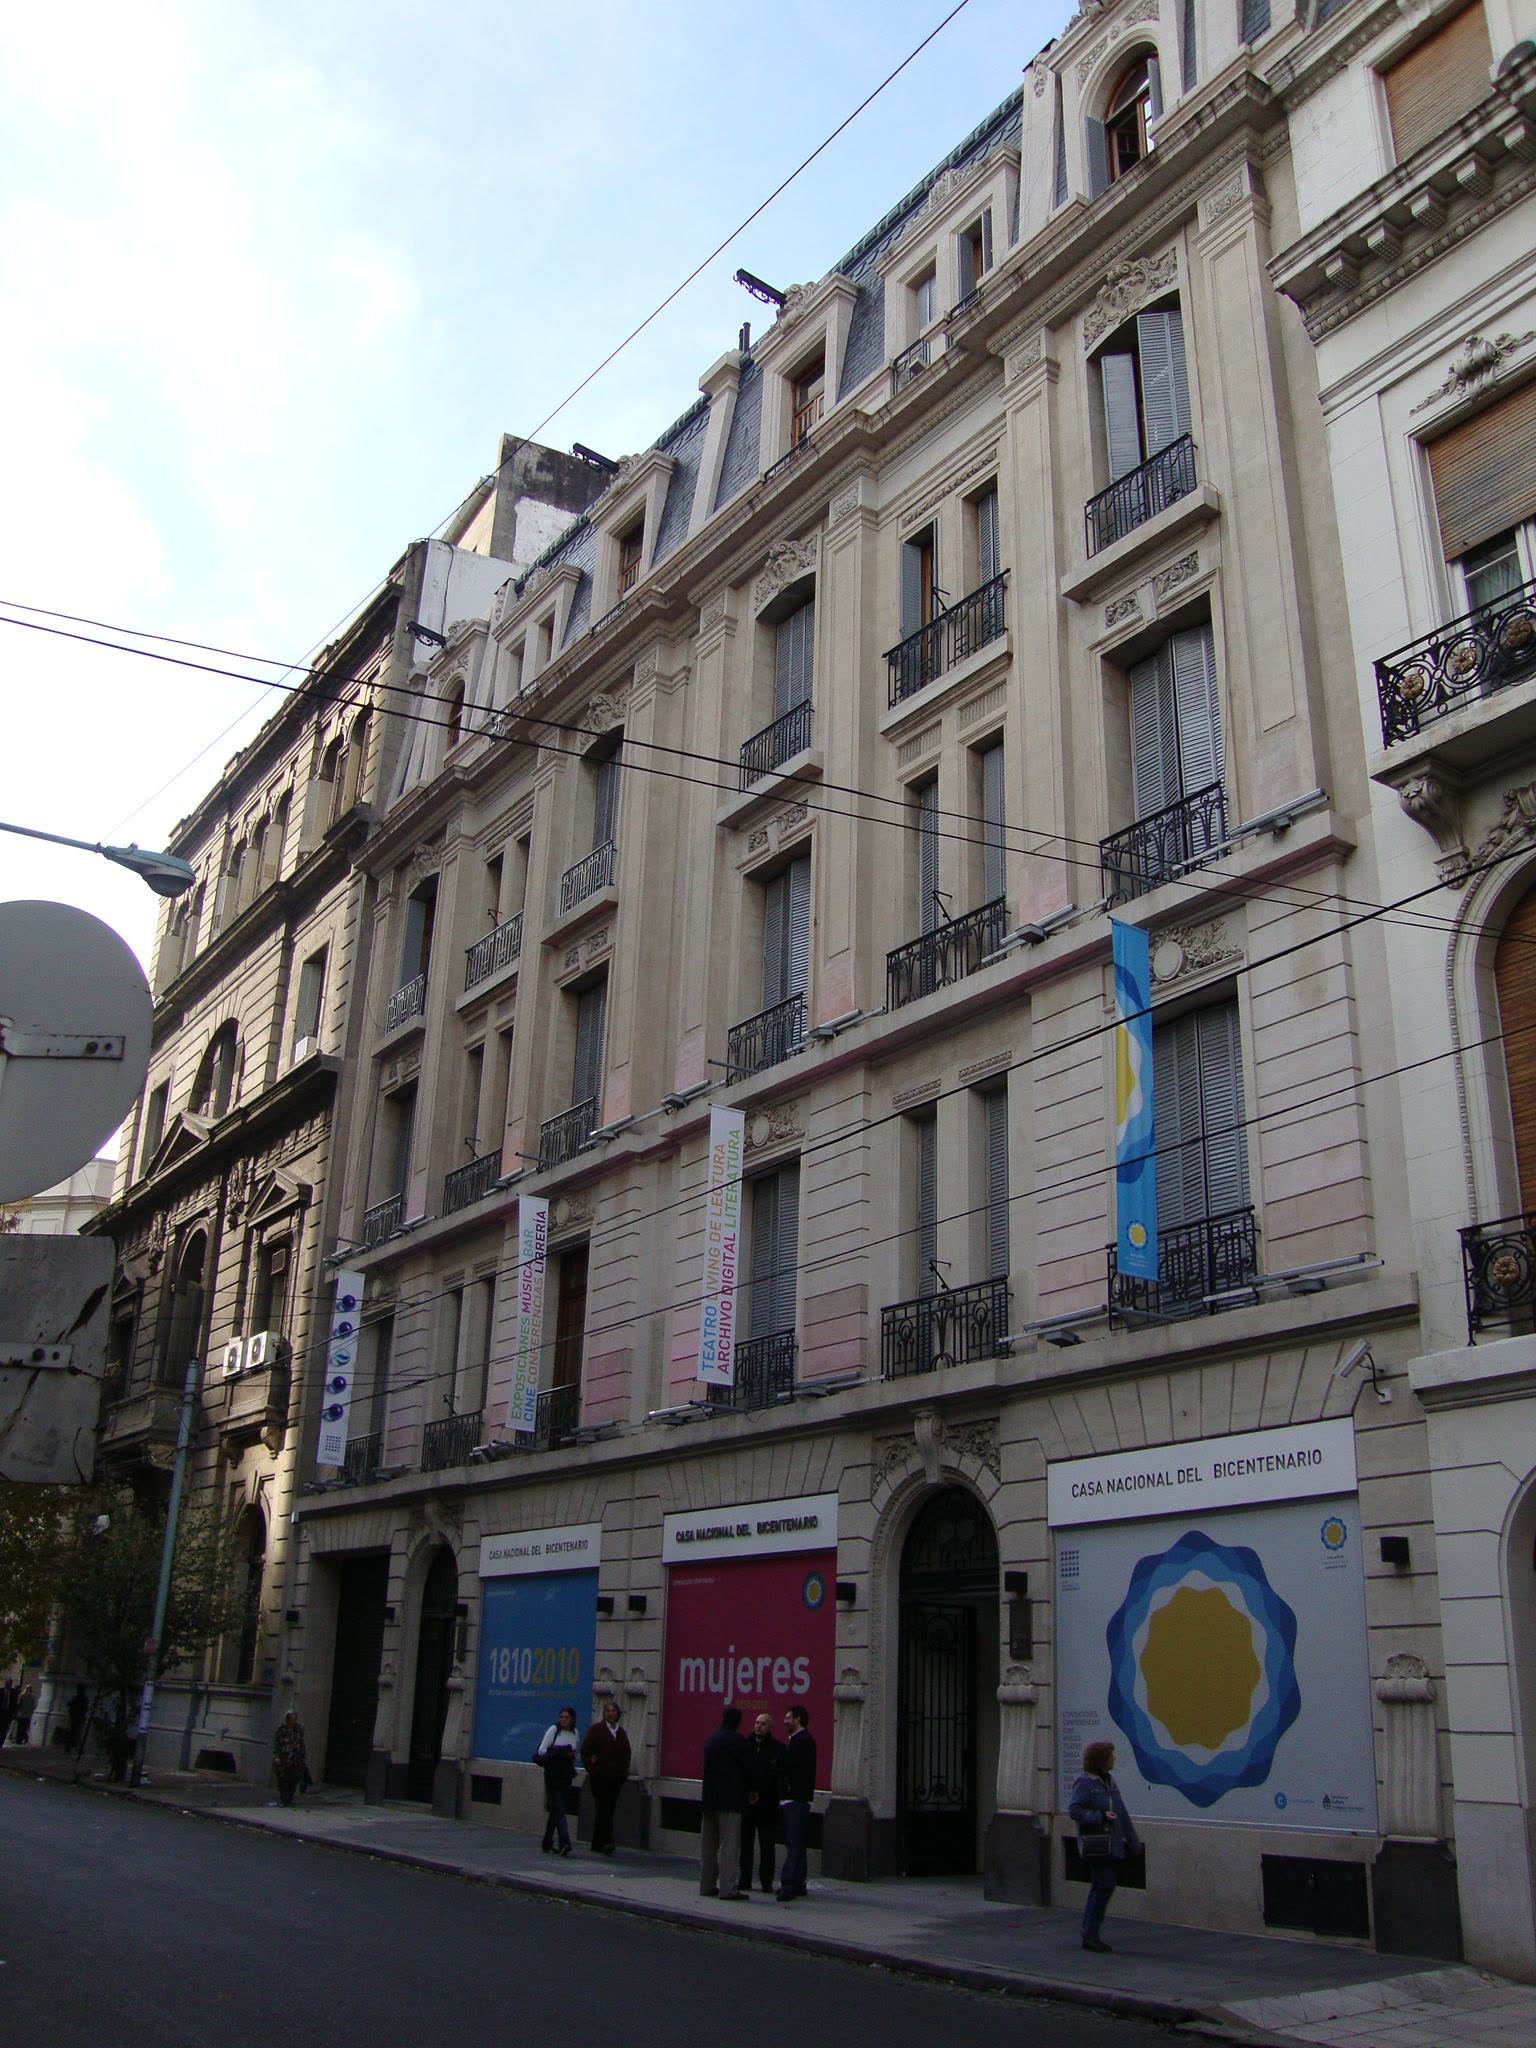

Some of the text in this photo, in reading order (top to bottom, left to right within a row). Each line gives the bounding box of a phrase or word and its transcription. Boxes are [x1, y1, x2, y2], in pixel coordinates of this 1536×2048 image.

[702, 1143, 726, 1371] TEATRO LIVING DE LECTURA
[717, 1129, 740, 1374] ARCHIVO DIGITAL LITERATURA
[511, 1229, 533, 1420] EXPOSICIONES MÚSICA BAR
[523, 1210, 546, 1422] CINE CONFERENCIAS LIBRERÍA
[675, 1515, 819, 1543] CASA NACIONAL DEL BICENTENARIO
[1071, 1449, 1323, 1498] CASA NACIONAL DEL BICENTENARIO
[488, 1539, 589, 1560] CASA NACIONAL DEL BICENTENARIO
[679, 1644, 811, 1705] mujeres
